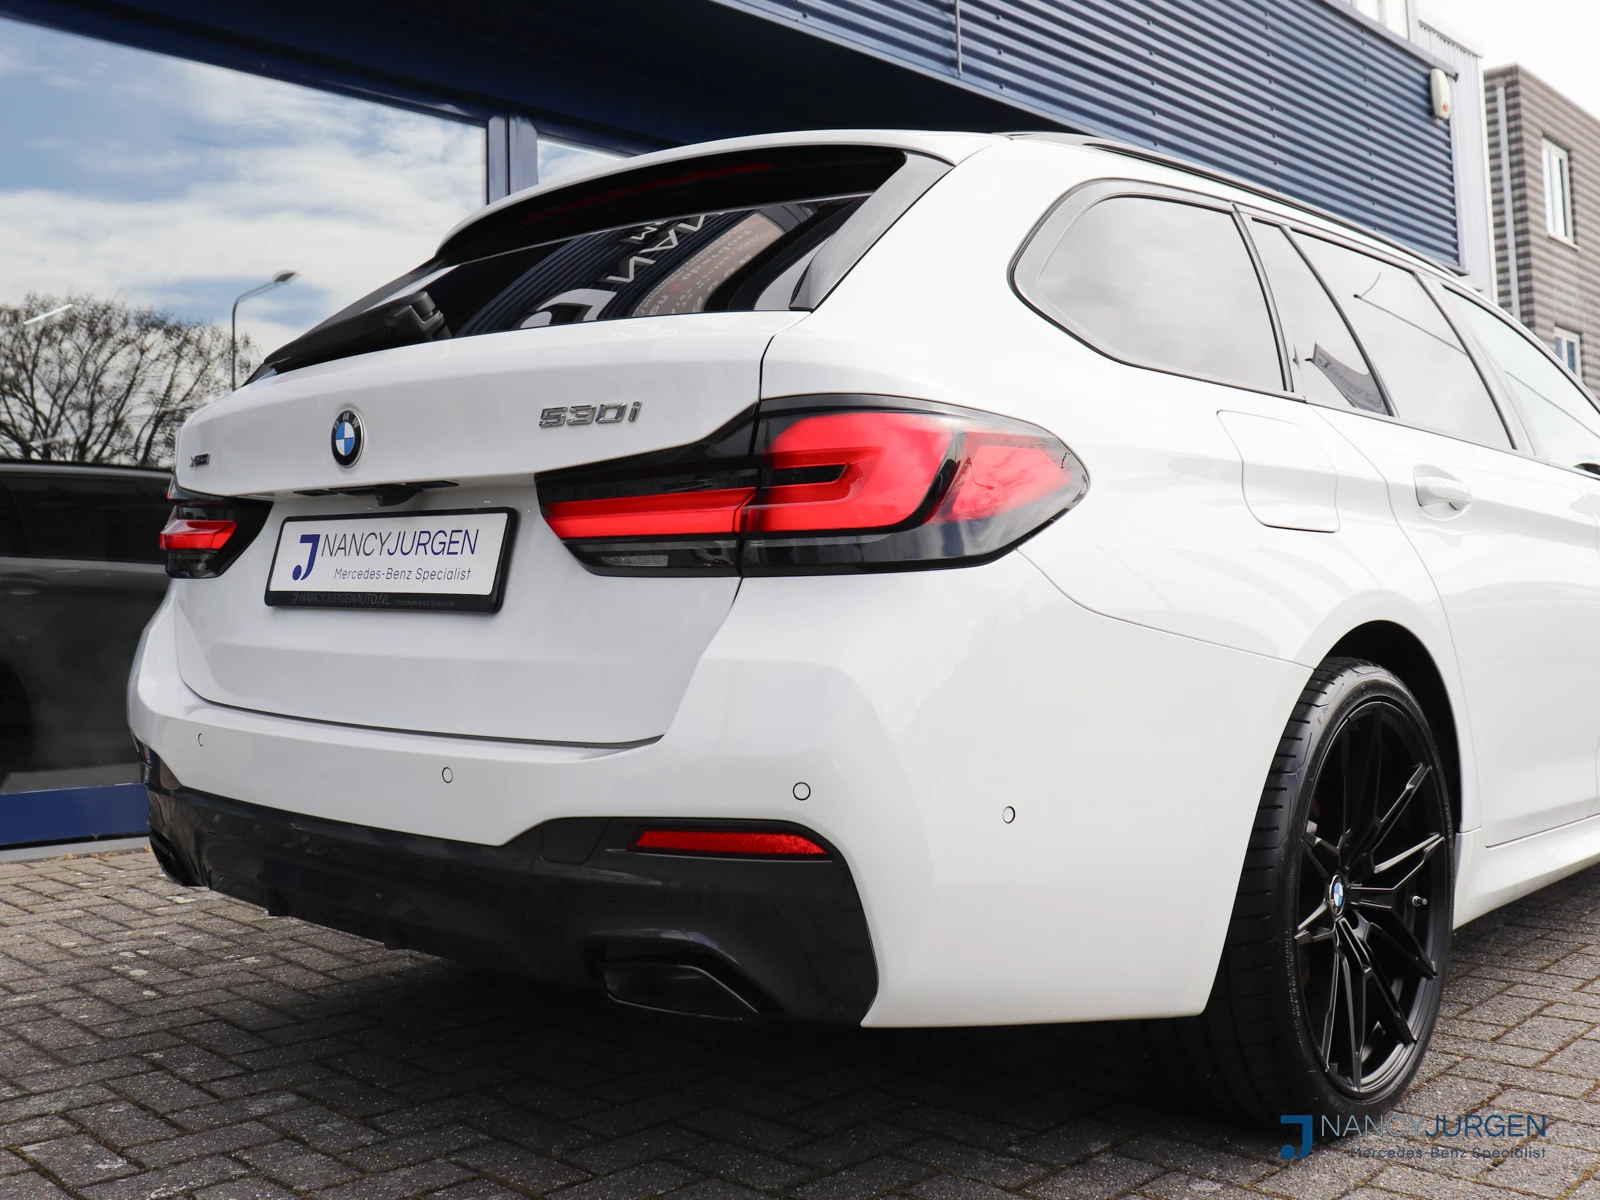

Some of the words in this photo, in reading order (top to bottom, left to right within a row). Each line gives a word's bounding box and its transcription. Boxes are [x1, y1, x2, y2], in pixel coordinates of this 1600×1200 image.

[538, 401, 643, 428] 530i
[321, 529, 479, 557] NANCYJURGEN
[334, 567, 412, 580] Mercedes-Benz
[415, 567, 471, 583] Specialist
